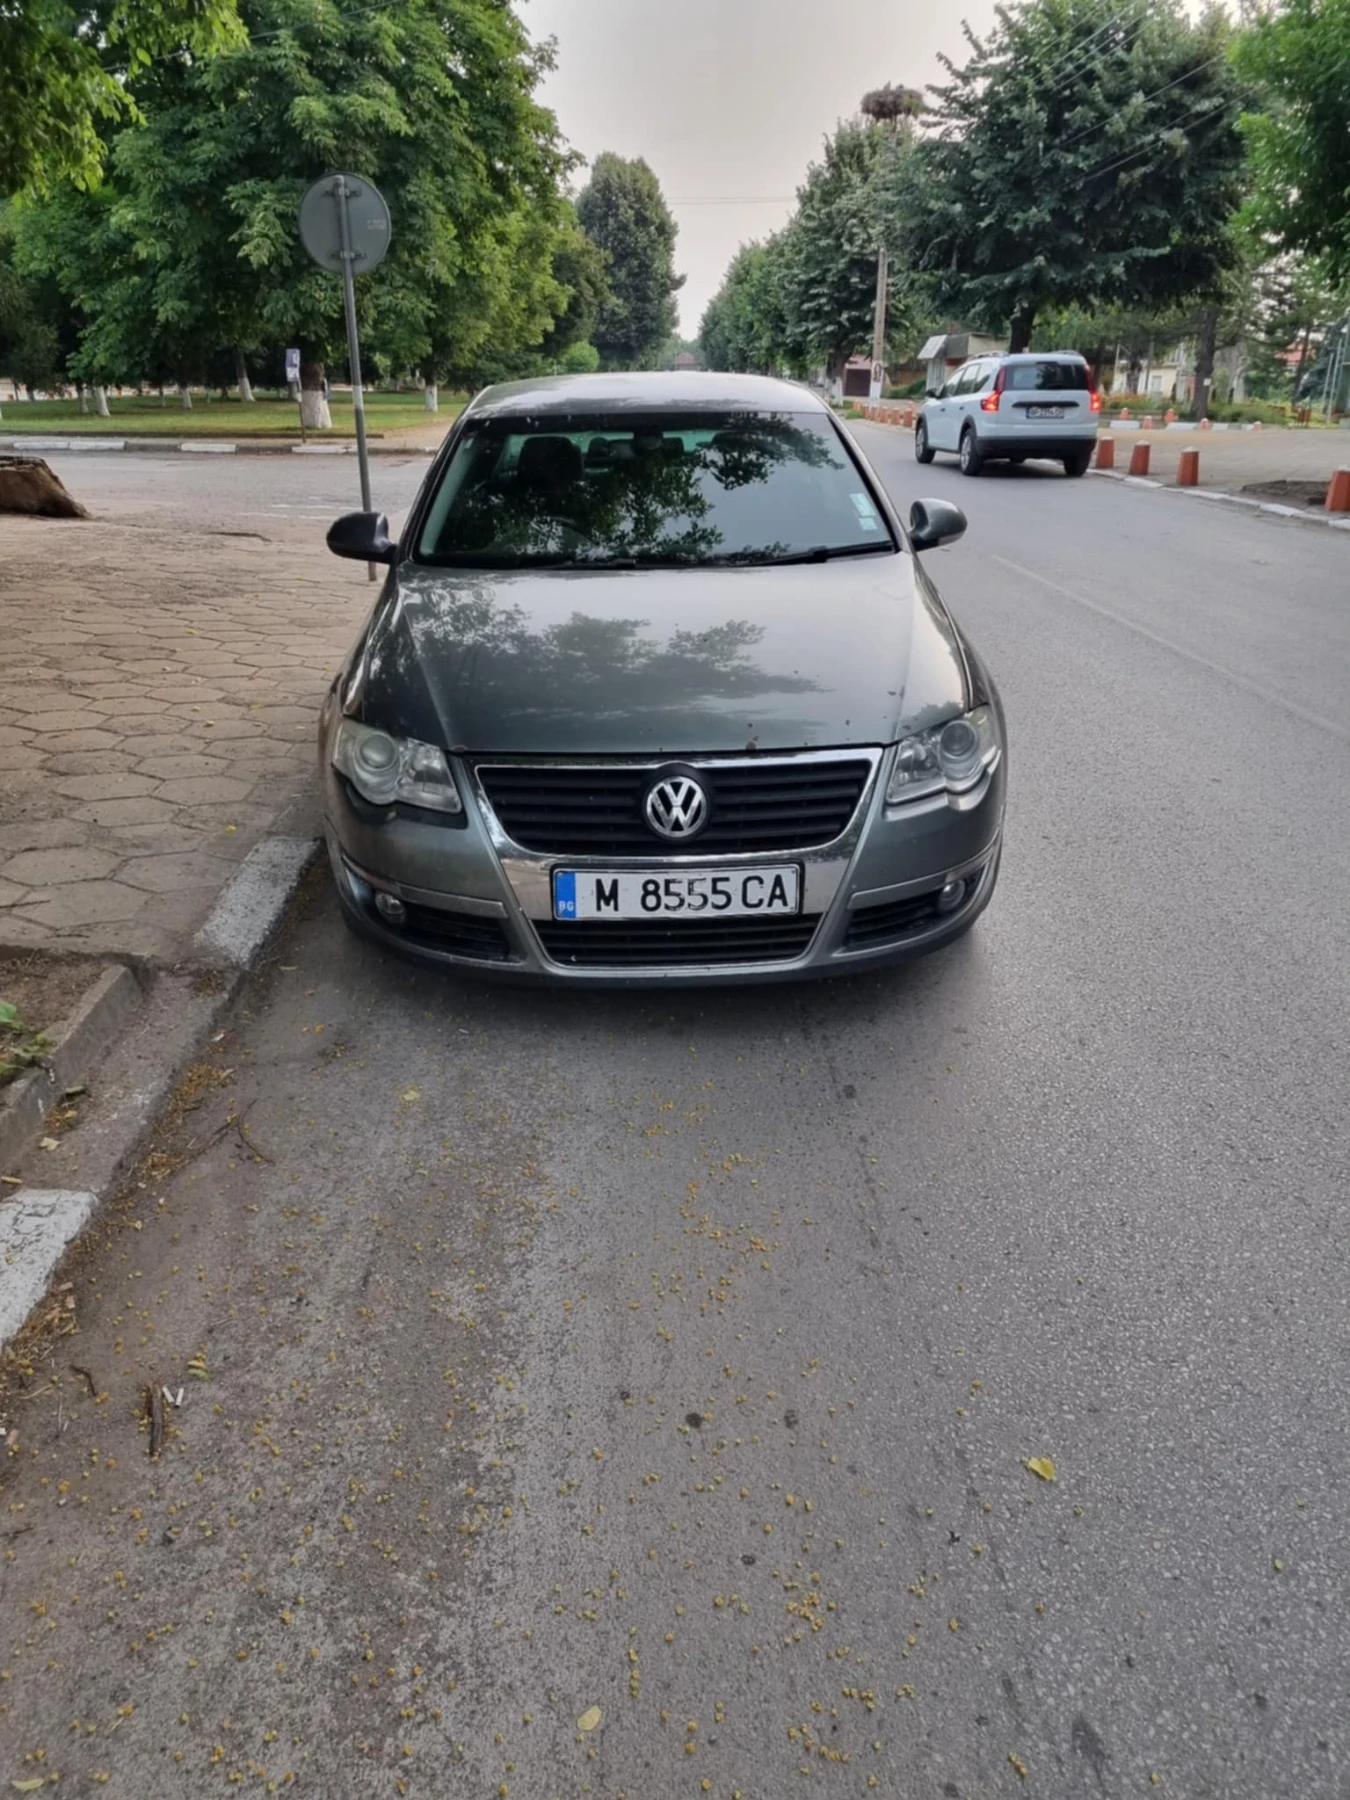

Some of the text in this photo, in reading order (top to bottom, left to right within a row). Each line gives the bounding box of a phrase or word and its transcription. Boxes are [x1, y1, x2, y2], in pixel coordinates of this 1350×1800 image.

[595, 874, 789, 912] M 8555 CA
[558, 900, 575, 912] BG
